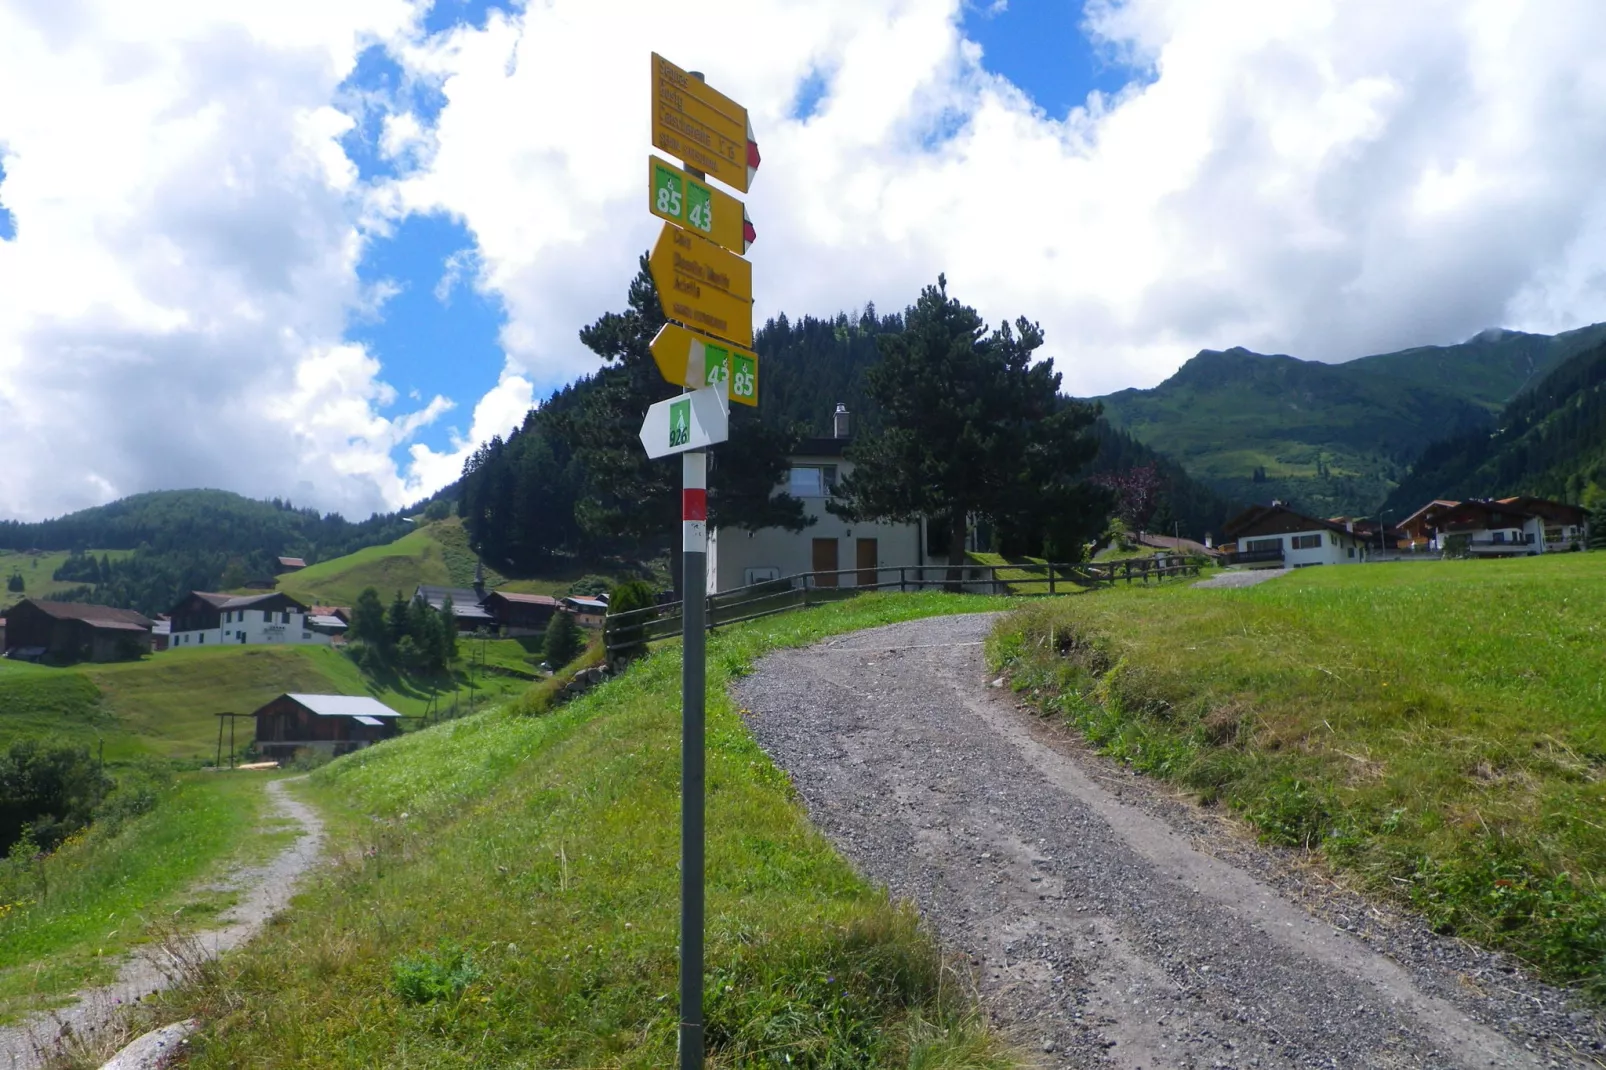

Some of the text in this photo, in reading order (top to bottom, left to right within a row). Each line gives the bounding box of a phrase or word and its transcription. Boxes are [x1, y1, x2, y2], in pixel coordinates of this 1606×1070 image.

[657, 187, 682, 216] 85
[689, 204, 712, 232] 43
[733, 372, 755, 396] 85
[669, 426, 689, 447] 926
